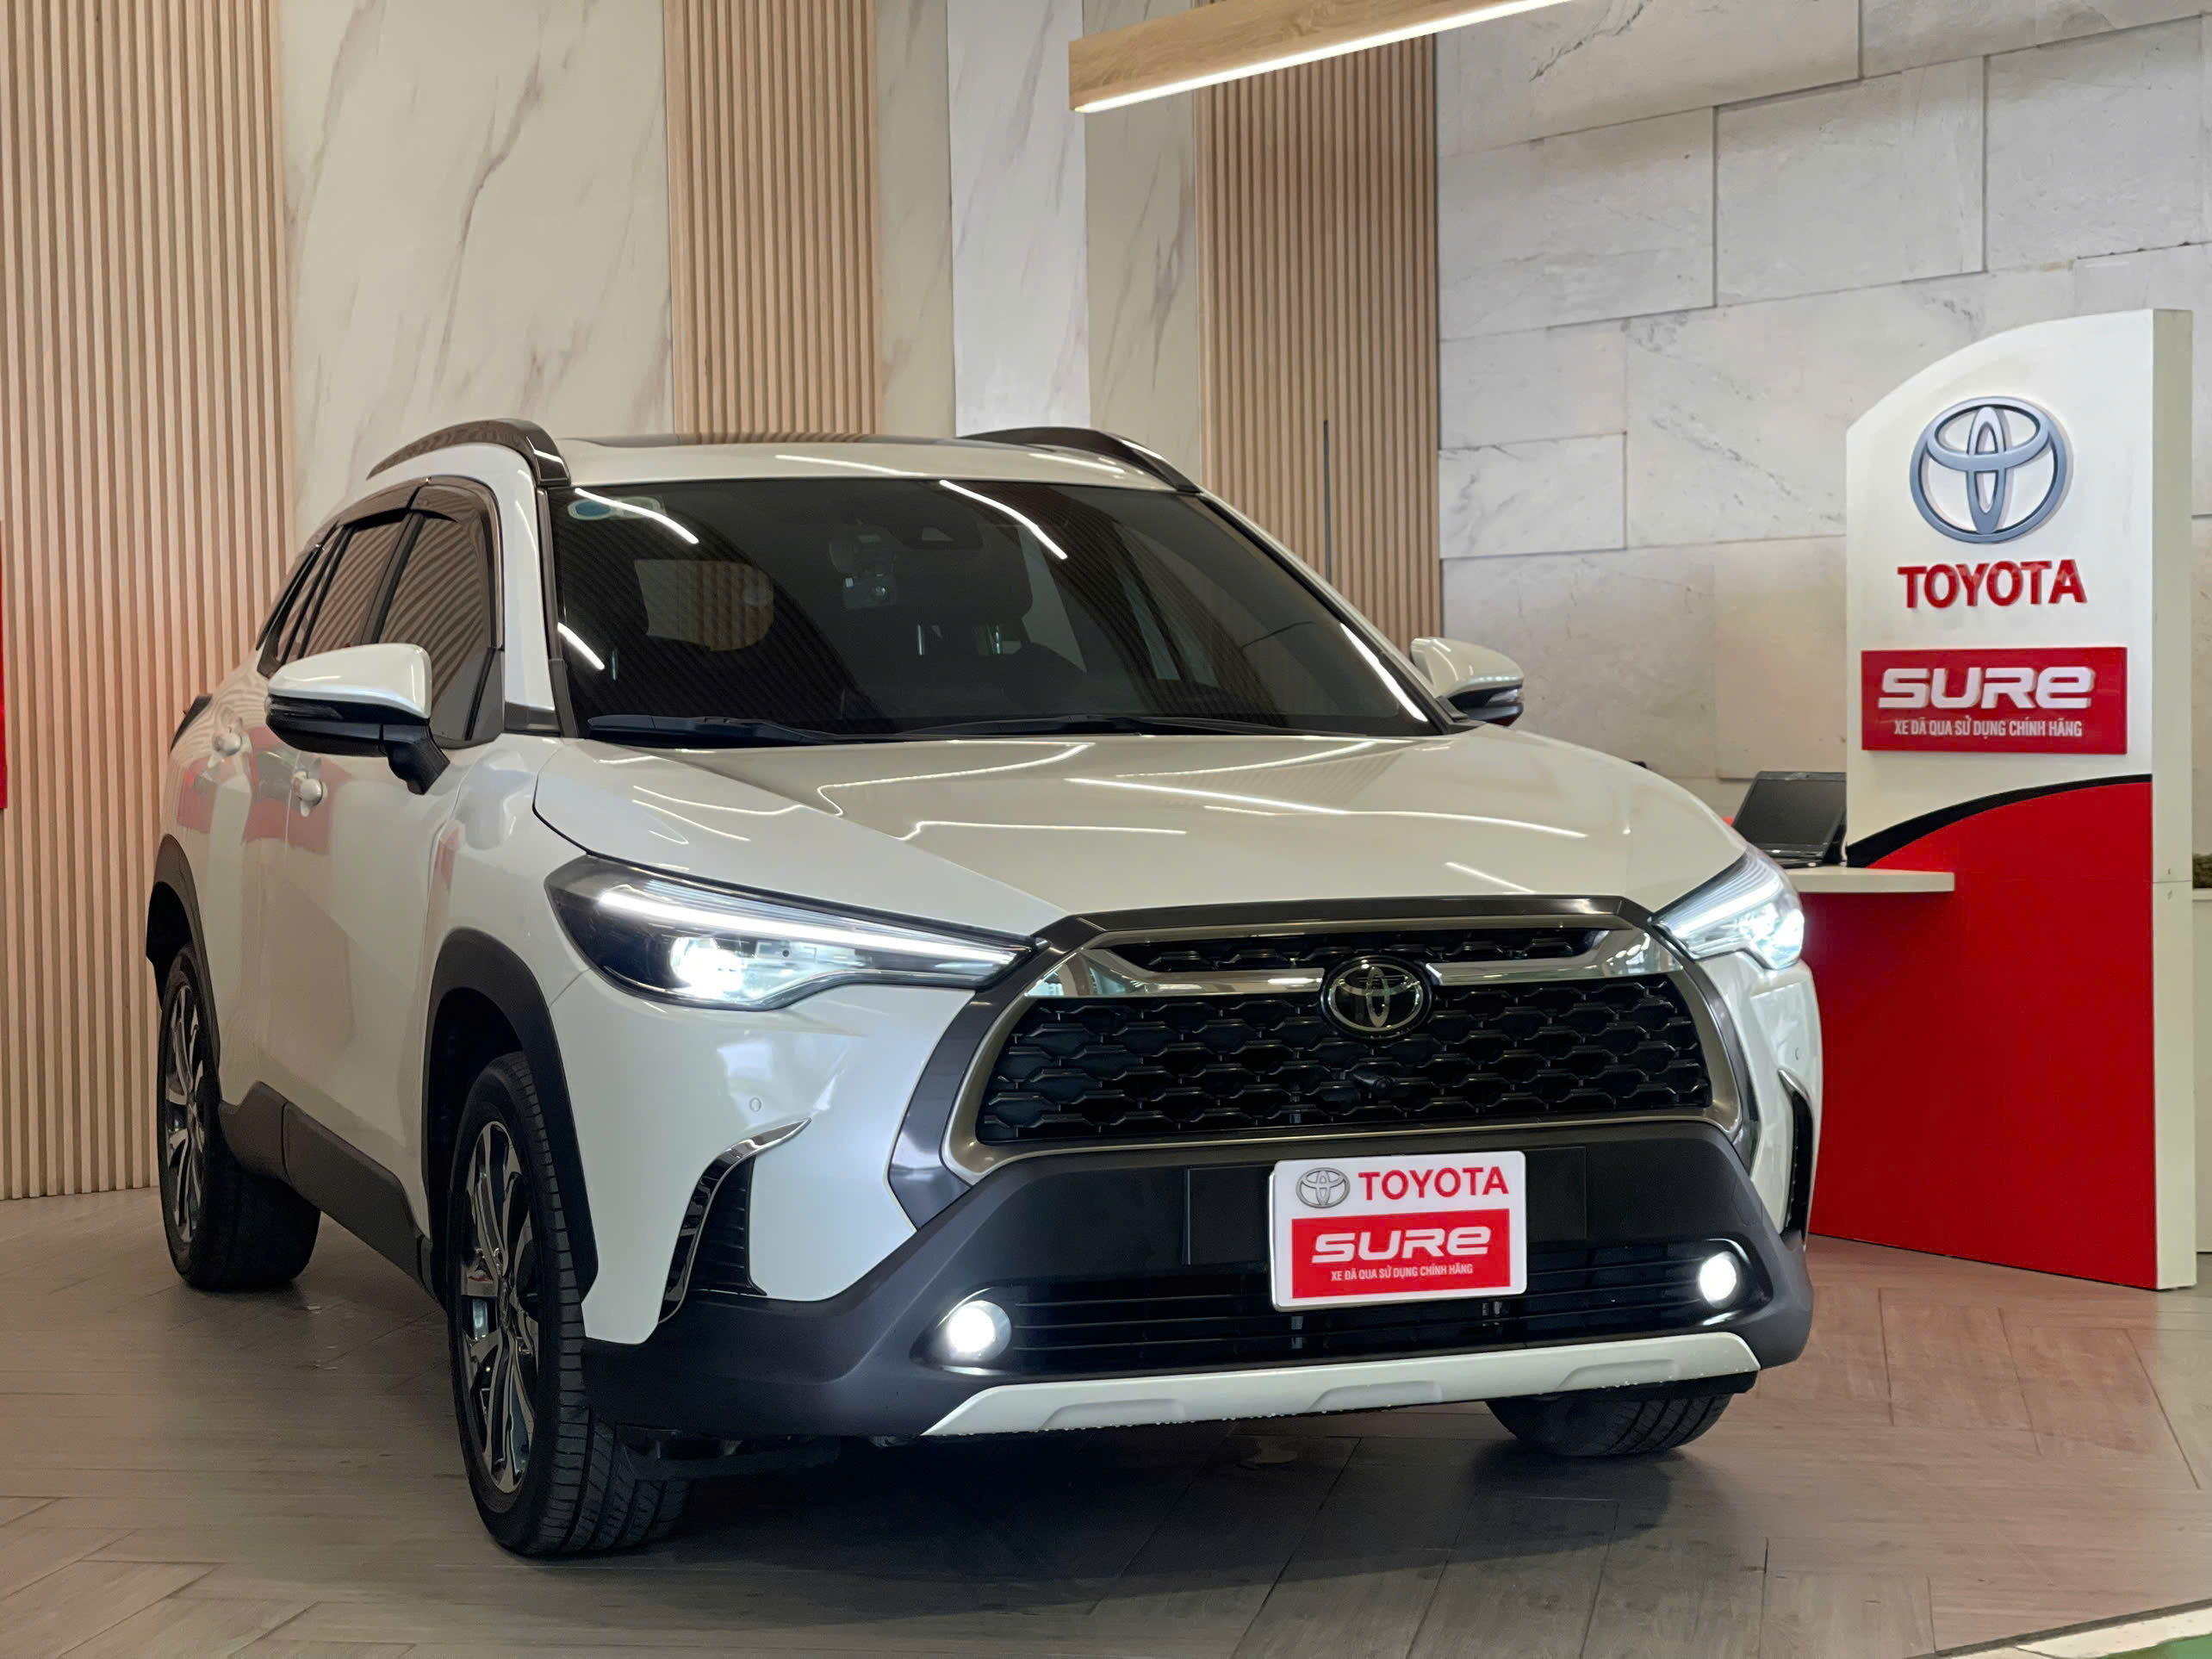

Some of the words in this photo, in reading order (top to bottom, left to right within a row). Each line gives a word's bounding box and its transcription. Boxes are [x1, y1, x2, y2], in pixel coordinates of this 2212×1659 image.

[1898, 559, 2087, 608] TOYOTA
[1894, 720, 1909, 735] XE
[1929, 720, 1952, 736] QUA
[1973, 720, 2006, 739] DỤNG
[2009, 717, 2045, 736] CHÍNH
[1358, 1166, 1509, 1200] TOYOTA
[1331, 1271, 1343, 1281] XE
[1358, 1269, 1377, 1279] QUA
[1393, 1266, 1419, 1279] DỤNG
[1420, 1263, 1447, 1276] CHÍNH
